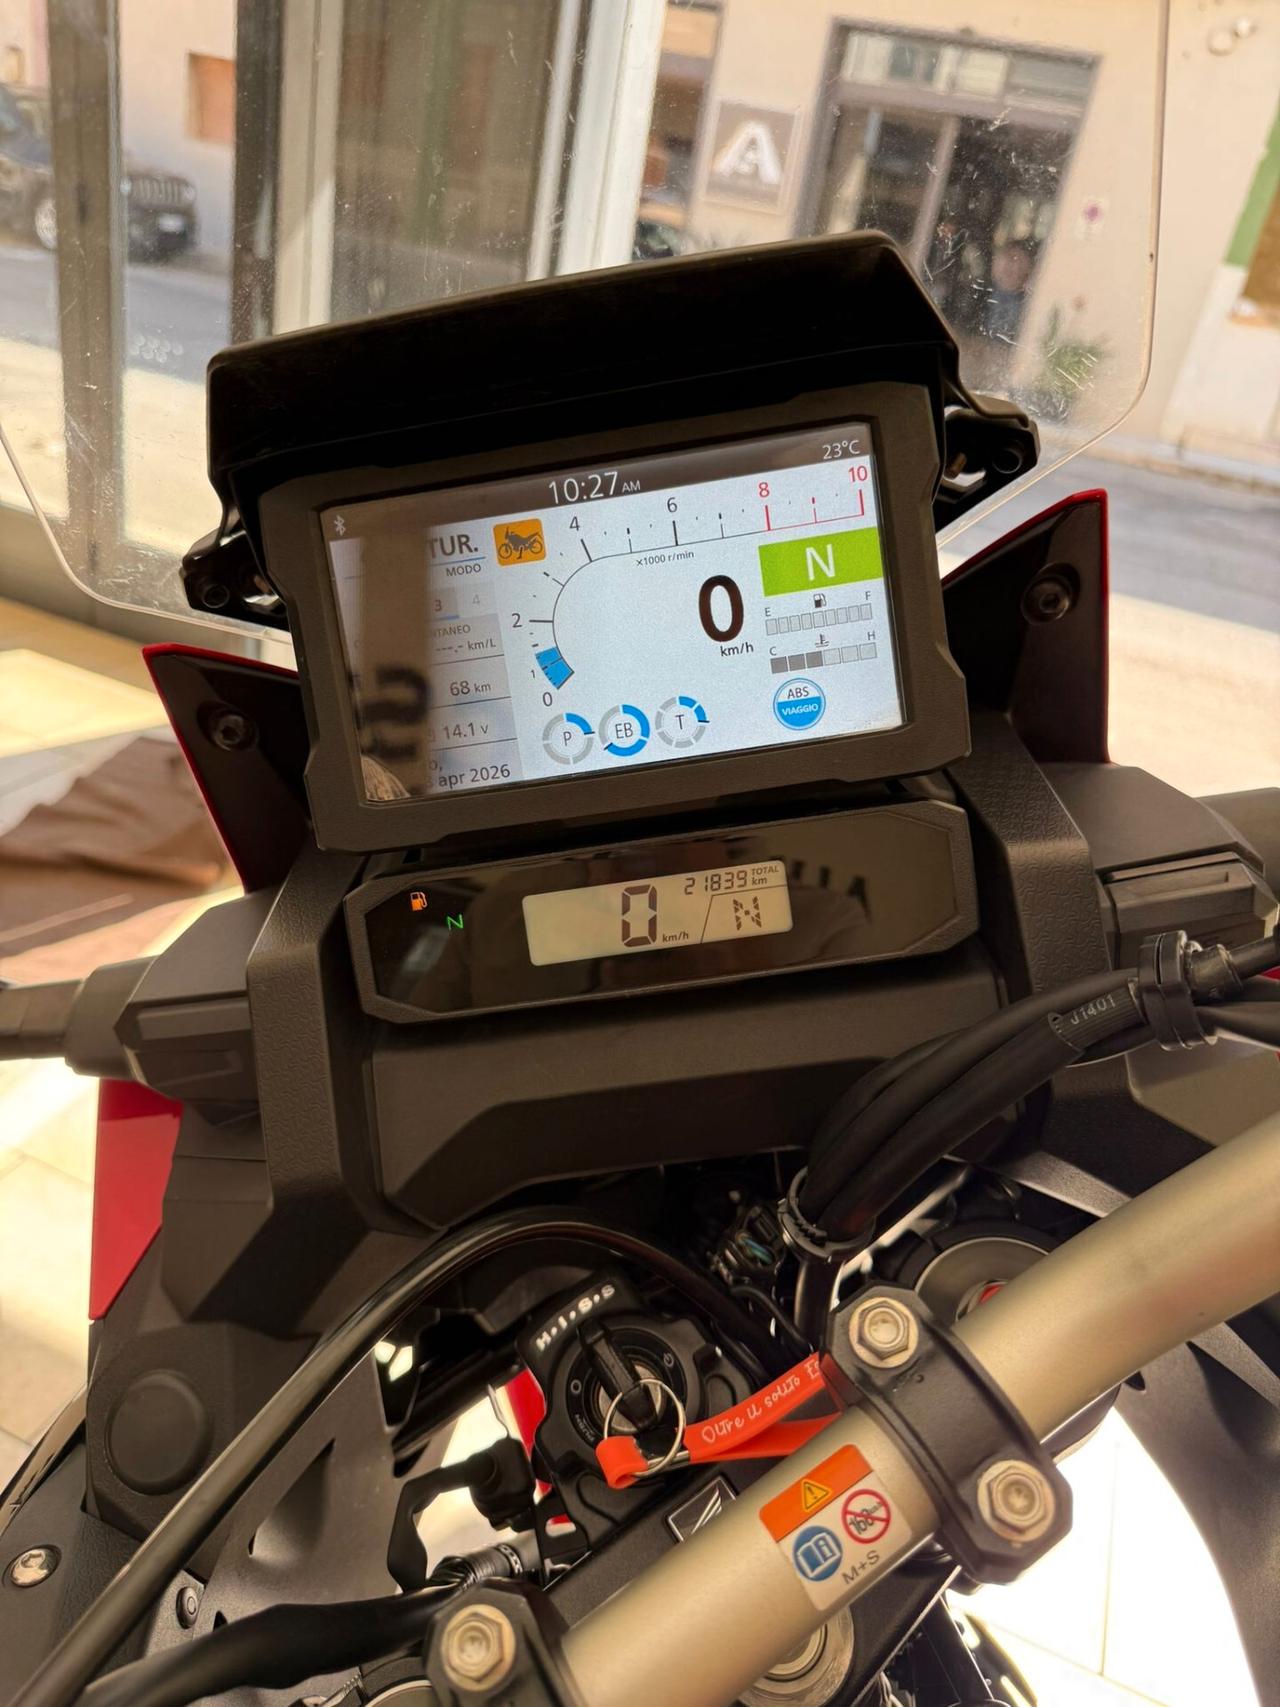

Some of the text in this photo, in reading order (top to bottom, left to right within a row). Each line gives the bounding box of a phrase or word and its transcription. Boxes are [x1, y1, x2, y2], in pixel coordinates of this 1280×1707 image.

[823, 440, 860, 460] 23°C
[848, 465, 868, 482] 10
[549, 471, 641, 504] 10:27 AM
[758, 482, 770, 498] 8
[666, 497, 678, 513] 6
[569, 516, 580, 531] 4
[668, 550, 694, 562] r/min
[805, 543, 836, 581] N
[446, 563, 481, 577] MODO
[865, 591, 872, 600] F
[434, 599, 442, 612] 3
[698, 574, 744, 643] 0
[765, 607, 772, 617] E
[511, 612, 523, 628] 2
[867, 631, 876, 640] H
[467, 638, 497, 651] km/L
[720, 641, 754, 657] km/h
[769, 646, 777, 656] C
[530, 669, 536, 679] 1
[450, 680, 491, 696] 68 km
[787, 686, 810, 700] ABS
[542, 692, 553, 707] 0
[781, 703, 819, 717] VIAGGIO
[675, 714, 685, 730] T
[443, 722, 475, 740] 14.1
[563, 731, 573, 747] P
[615, 722, 634, 740] EB
[438, 772, 465, 789] apr
[469, 763, 511, 783] 2026
[684, 865, 779, 896] 21839 TOTAL
[751, 877, 768, 886] km
[621, 884, 658, 948] 0
[732, 896, 762, 931] N
[446, 913, 464, 931] N
[662, 932, 689, 943] km/h
[841, 1550, 881, 1586] M+S
